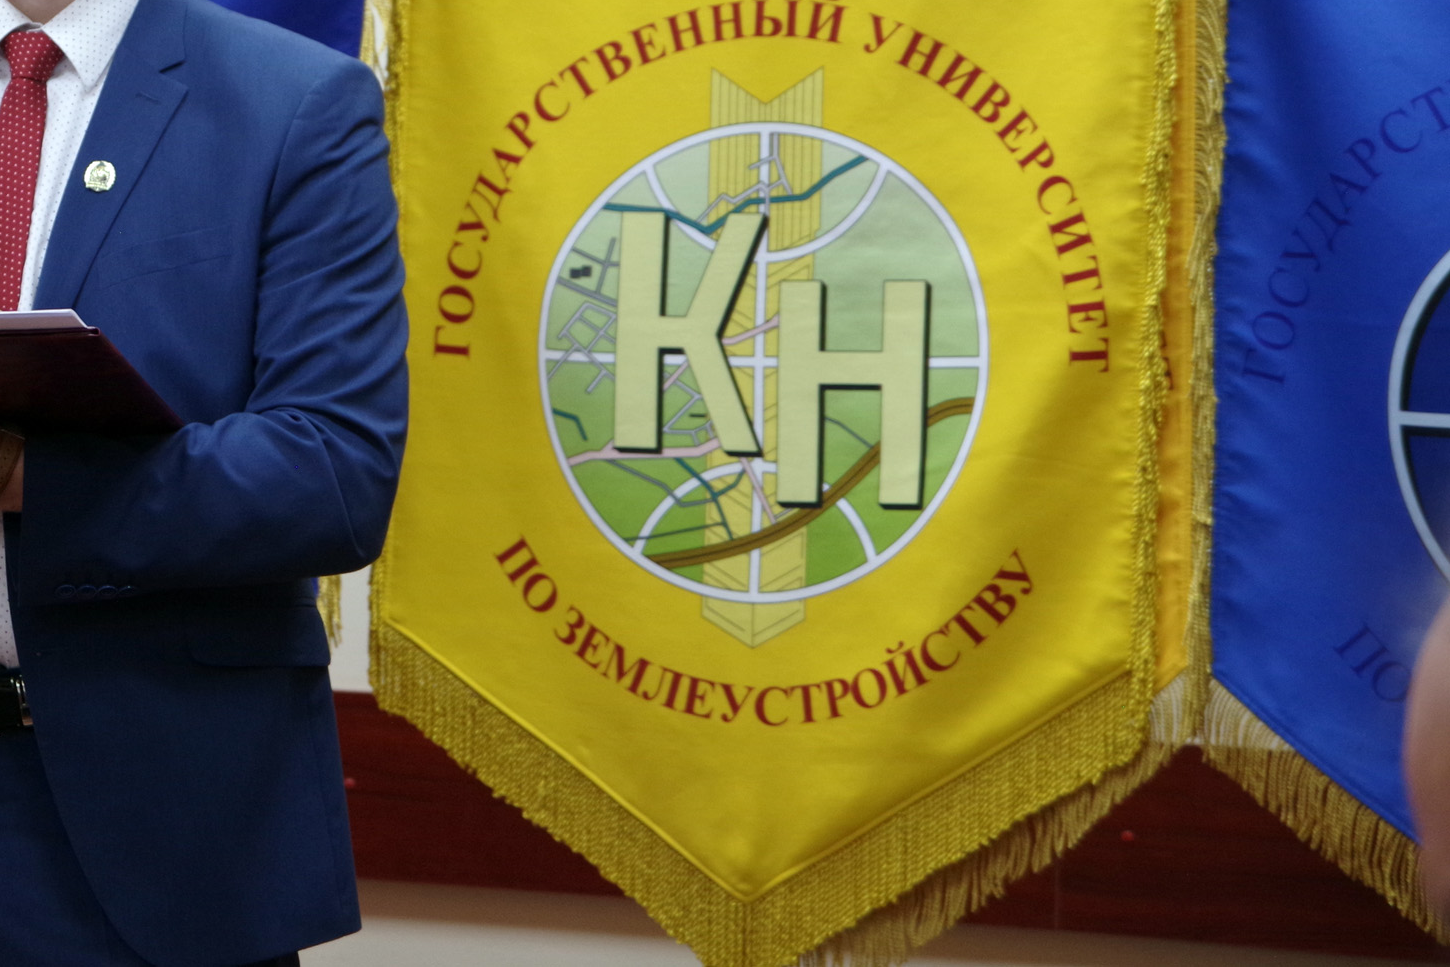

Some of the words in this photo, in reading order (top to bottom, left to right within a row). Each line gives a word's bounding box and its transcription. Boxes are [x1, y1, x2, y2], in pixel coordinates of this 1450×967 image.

[863, 13, 1111, 373] УНИВЕРСИТЕТ
[613, 212, 932, 510] КН
[493, 534, 558, 613] ПО
[553, 548, 1037, 728] ЗЕМЛЕУСТРОЙСТВУ
